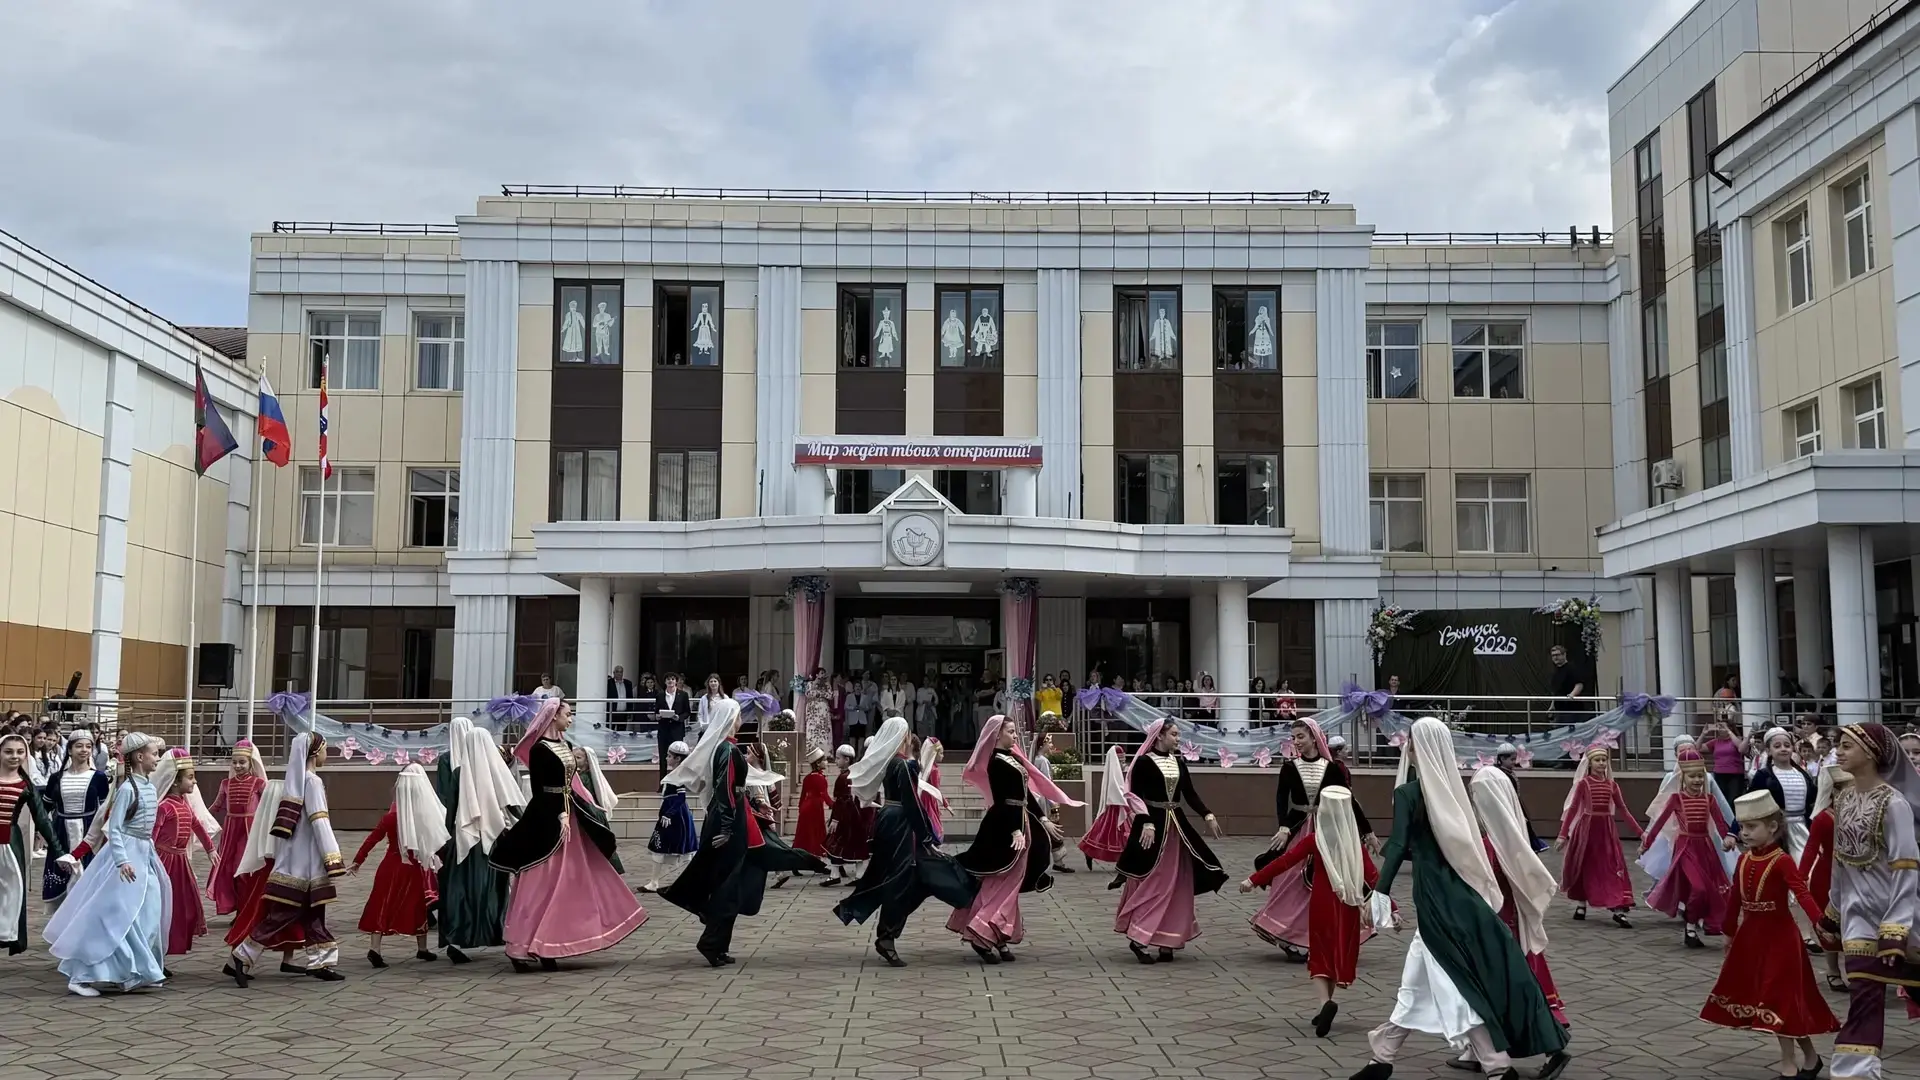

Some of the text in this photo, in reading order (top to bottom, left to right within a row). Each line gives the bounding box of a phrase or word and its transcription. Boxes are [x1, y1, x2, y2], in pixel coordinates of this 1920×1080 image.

[807, 441, 1031, 461] Мир ждёт твоих открытий!
[1439, 623, 1500, 646] Выпуск
